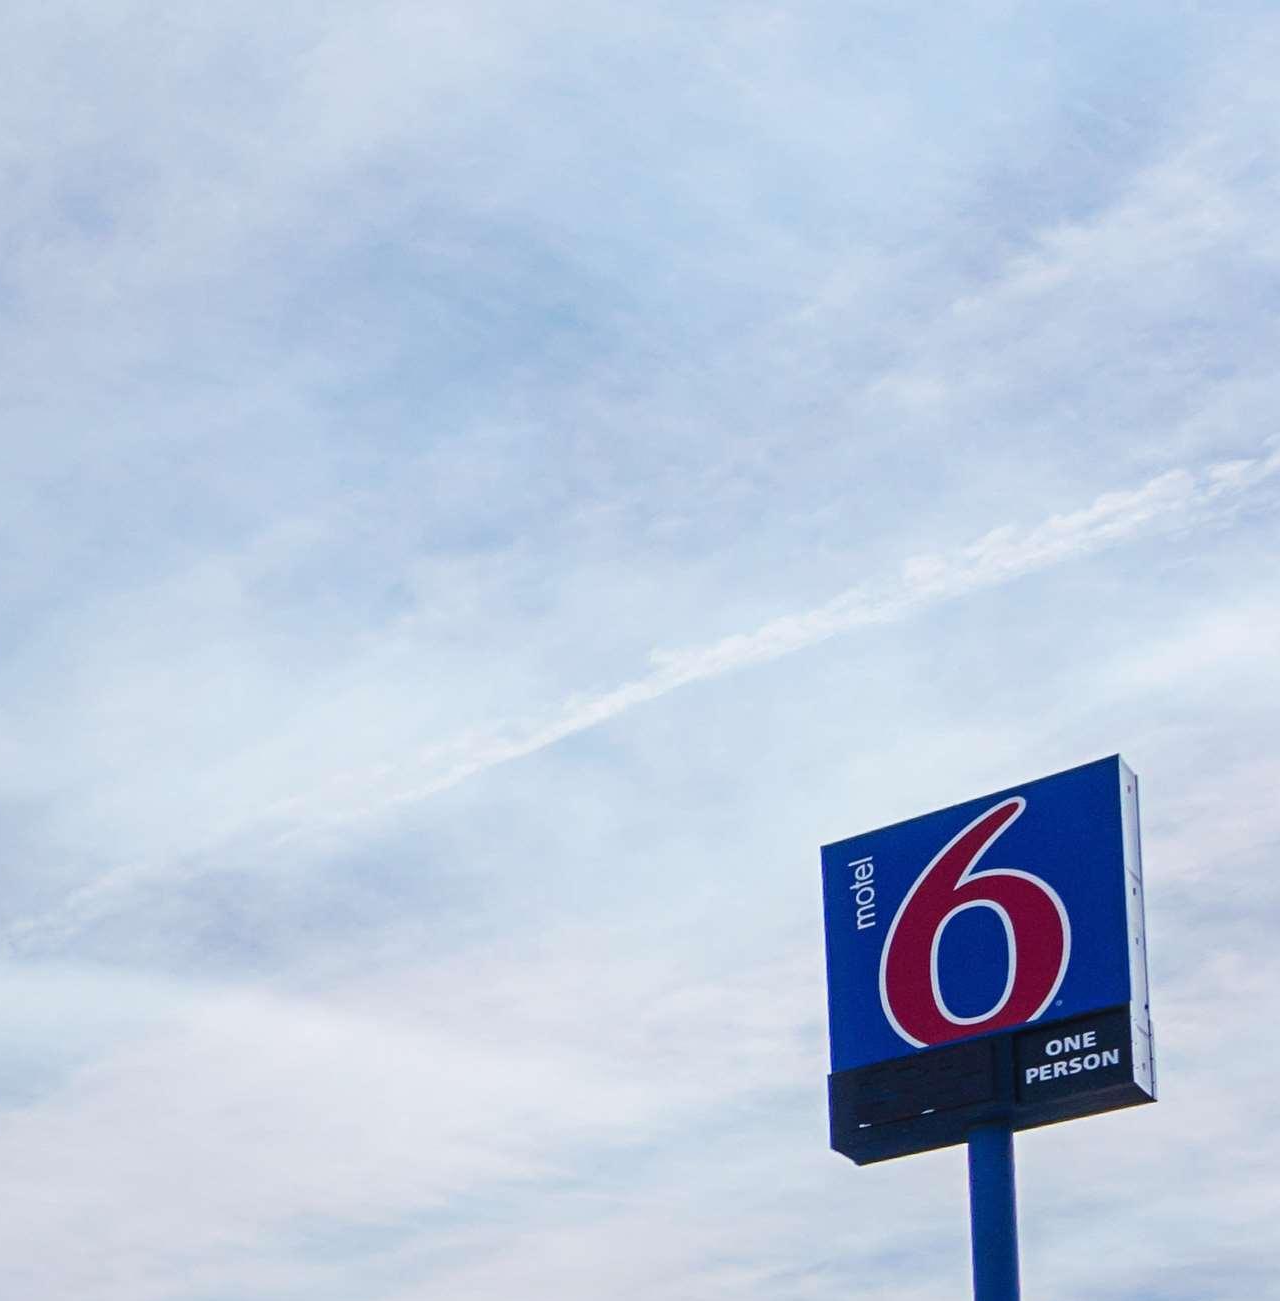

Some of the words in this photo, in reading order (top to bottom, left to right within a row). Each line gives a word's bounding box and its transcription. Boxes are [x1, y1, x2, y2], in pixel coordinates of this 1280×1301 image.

[848, 855, 876, 930] motel
[879, 796, 1071, 1048] 6
[1045, 1030, 1097, 1056] ONE
[1025, 1048, 1119, 1085] PERSON
